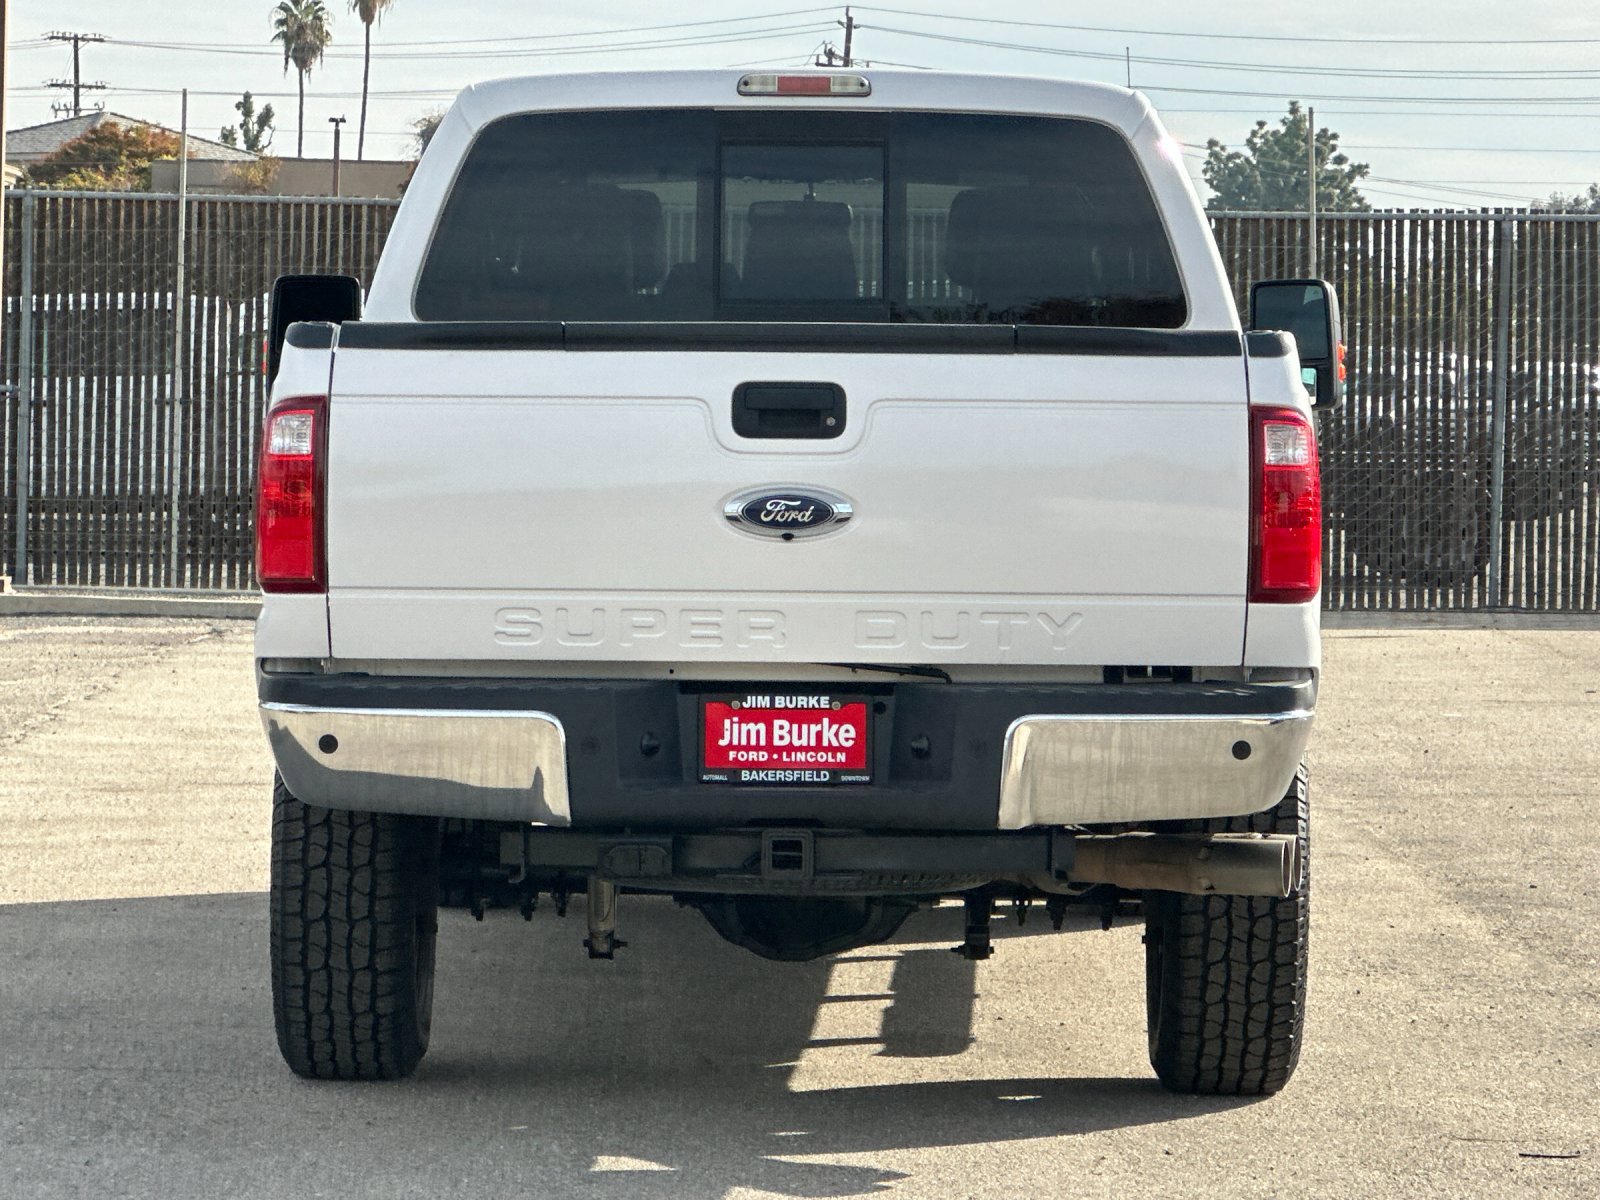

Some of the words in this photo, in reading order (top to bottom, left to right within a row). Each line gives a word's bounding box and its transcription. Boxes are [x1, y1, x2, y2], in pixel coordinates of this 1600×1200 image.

[760, 499, 815, 523] Ford
[494, 607, 787, 648] SUPER
[854, 610, 1083, 650] DUTY
[742, 695, 770, 709] JIM
[774, 696, 830, 709] BURKE
[717, 716, 767, 747] Jim
[773, 717, 856, 748] Burke
[728, 751, 769, 762] FORD
[782, 751, 846, 763] LINCOLN
[741, 770, 830, 782] BAKERSFIELD
